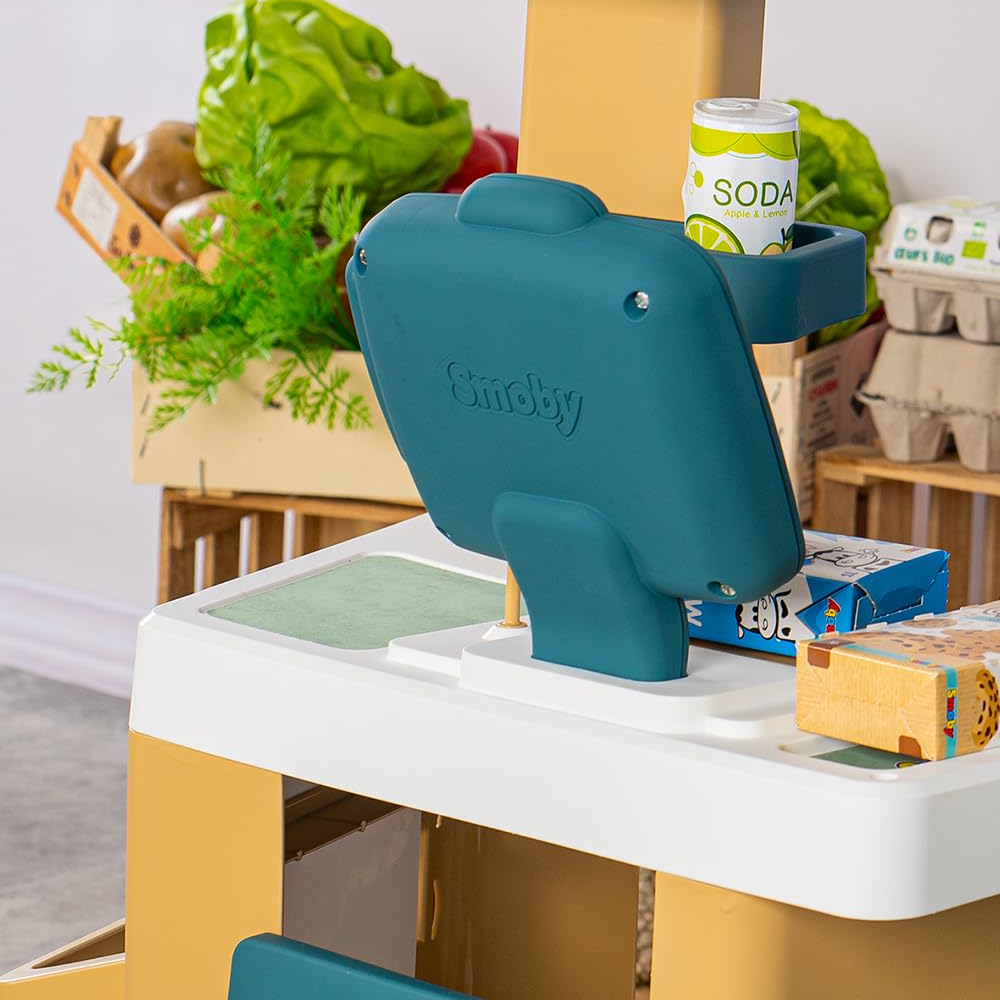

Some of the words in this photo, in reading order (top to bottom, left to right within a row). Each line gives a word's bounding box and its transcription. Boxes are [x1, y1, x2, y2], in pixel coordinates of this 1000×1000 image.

[713, 178, 793, 207] SODA
[724, 209, 750, 220] Apple
[753, 210, 760, 218] &
[763, 209, 788, 218] Lemon
[447, 361, 583, 438] Smoby
[824, 597, 842, 633] moby
[944, 689, 957, 738] Smoby
